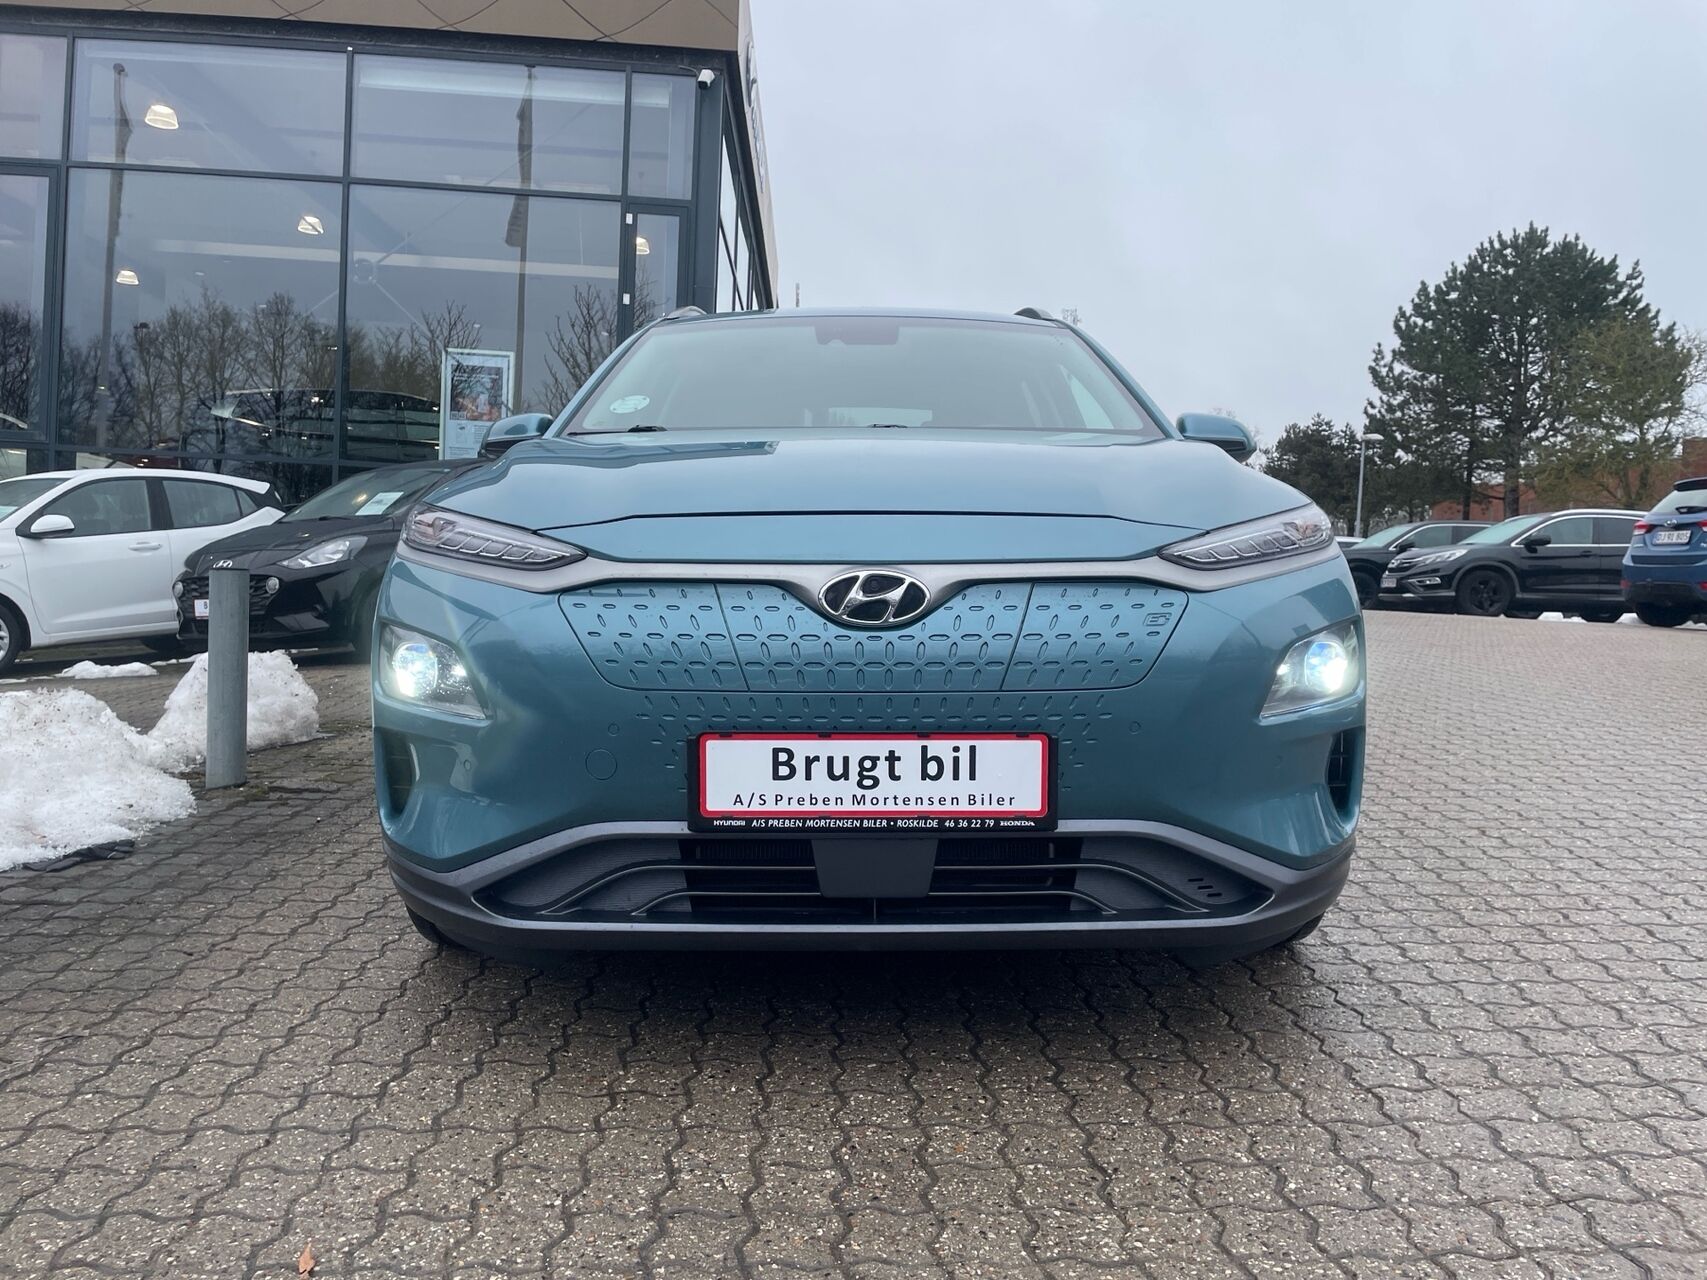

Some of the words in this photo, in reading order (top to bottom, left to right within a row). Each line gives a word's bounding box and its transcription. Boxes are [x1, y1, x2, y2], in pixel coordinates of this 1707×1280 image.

[771, 747, 902, 790] Brugt
[920, 744, 977, 782] bil
[732, 791, 767, 808] A/S
[774, 792, 844, 807] Preben
[851, 792, 960, 807] Mortensen
[967, 792, 1016, 807] Biler
[751, 819, 766, 828] A/S
[767, 819, 803, 828] PREBEN
[804, 819, 861, 828] MORTENSEN
[862, 819, 888, 828] BILER
[896, 819, 939, 828] ROSKILDE
[944, 819, 955, 828] 46
[957, 819, 969, 828] 36
[971, 819, 982, 828] 22
[984, 819, 995, 828] 79
